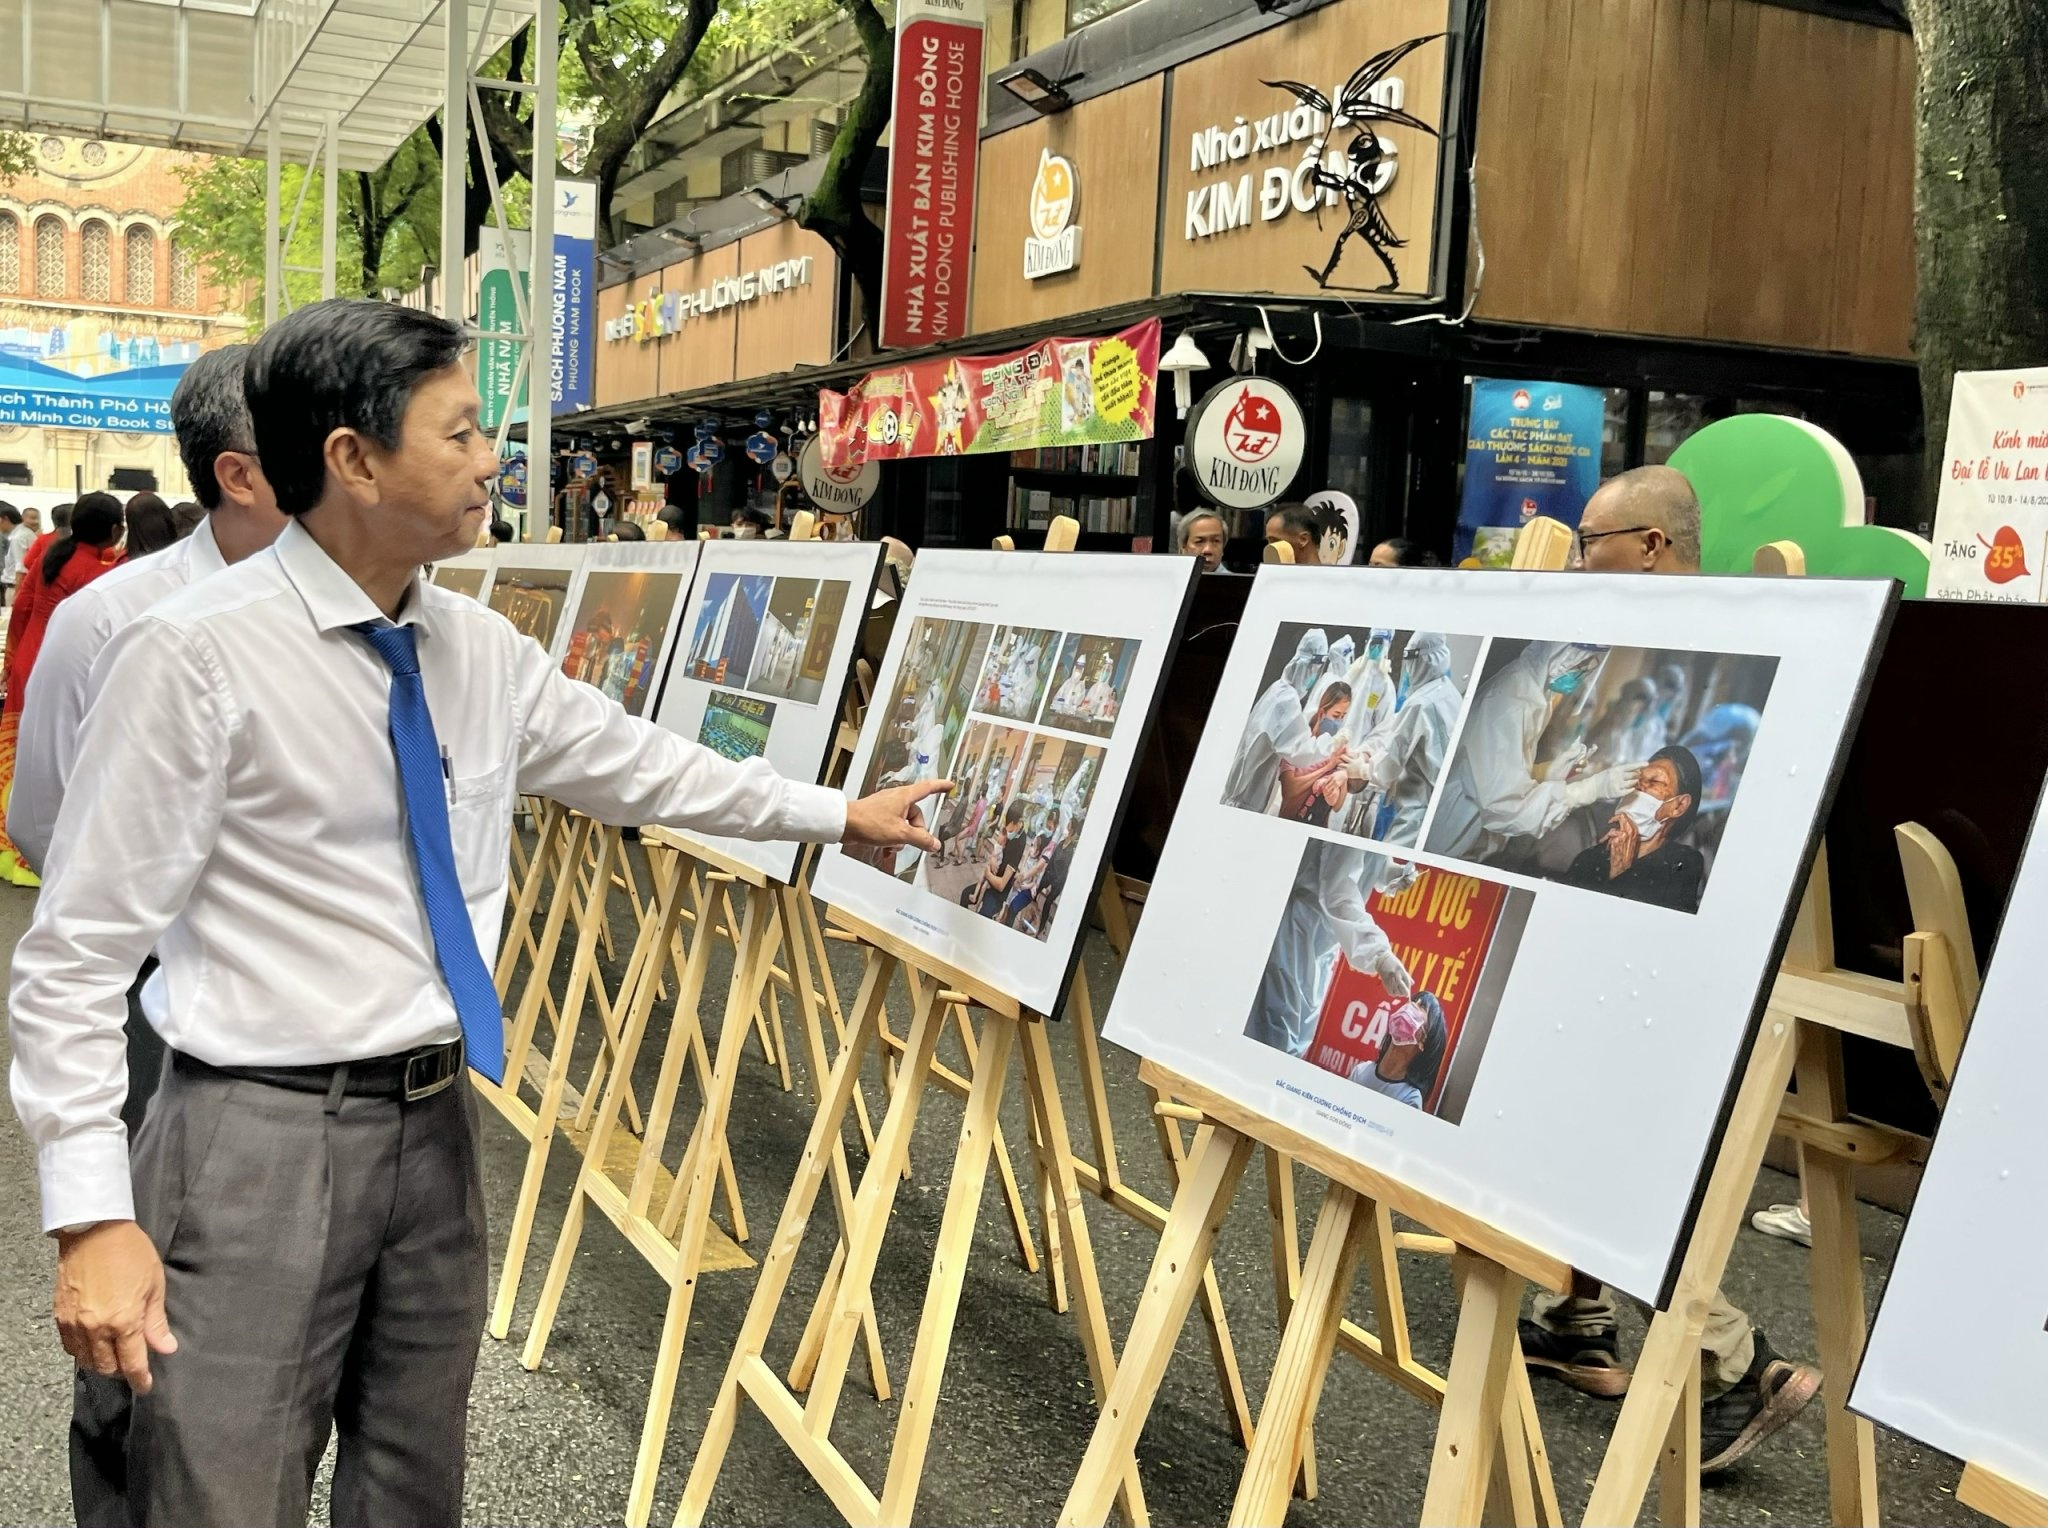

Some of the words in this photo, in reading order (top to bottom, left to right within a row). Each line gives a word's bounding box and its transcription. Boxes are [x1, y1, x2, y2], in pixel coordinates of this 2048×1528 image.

[914, 37, 940, 107] ĐỒNG
[945, 41, 965, 109] HOUSE
[916, 114, 936, 157] KIM
[1191, 116, 1249, 172] Nhà
[909, 163, 932, 210] BẢN
[939, 115, 961, 227] PUBLISHING
[1185, 174, 1253, 241] KIM
[906, 216, 929, 278] XUẤT
[935, 233, 955, 295] DONG
[1027, 242, 1045, 273] KIM
[555, 255, 567, 290] NAM
[571, 270, 581, 303] BOOK
[758, 256, 813, 296] NAM
[570, 308, 581, 335] NAM
[905, 285, 925, 333] NHÀ
[932, 301, 949, 336] KIM
[497, 361, 511, 396] NHÃ
[568, 339, 580, 390] PHUONG
[0, 392, 25, 405] ch
[32, 394, 94, 409] Thành
[101, 398, 138, 412] Phố
[0, 408, 15, 420] hi
[21, 410, 63, 424] Minh
[68, 414, 102, 428] City
[107, 416, 150, 429] Book
[155, 420, 176, 431] St
[1528, 441, 1552, 453] SÁCH
[1993, 429, 2022, 449] Kính
[1209, 457, 1237, 489] KIM
[1952, 459, 1974, 485] Đại
[1978, 456, 1991, 480] lễ
[1995, 460, 2010, 480] Vu
[2015, 460, 2040, 481] Lan
[812, 477, 832, 501] KIM
[1998, 495, 2012, 504] 10/8
[1944, 540, 1977, 561] TẶNG
[1990, 543, 2023, 569] 35%
[1435, 947, 1471, 1002] TẾ
[1341, 999, 1401, 1049] CẤ
[1319, 1045, 1346, 1073] MỌI
